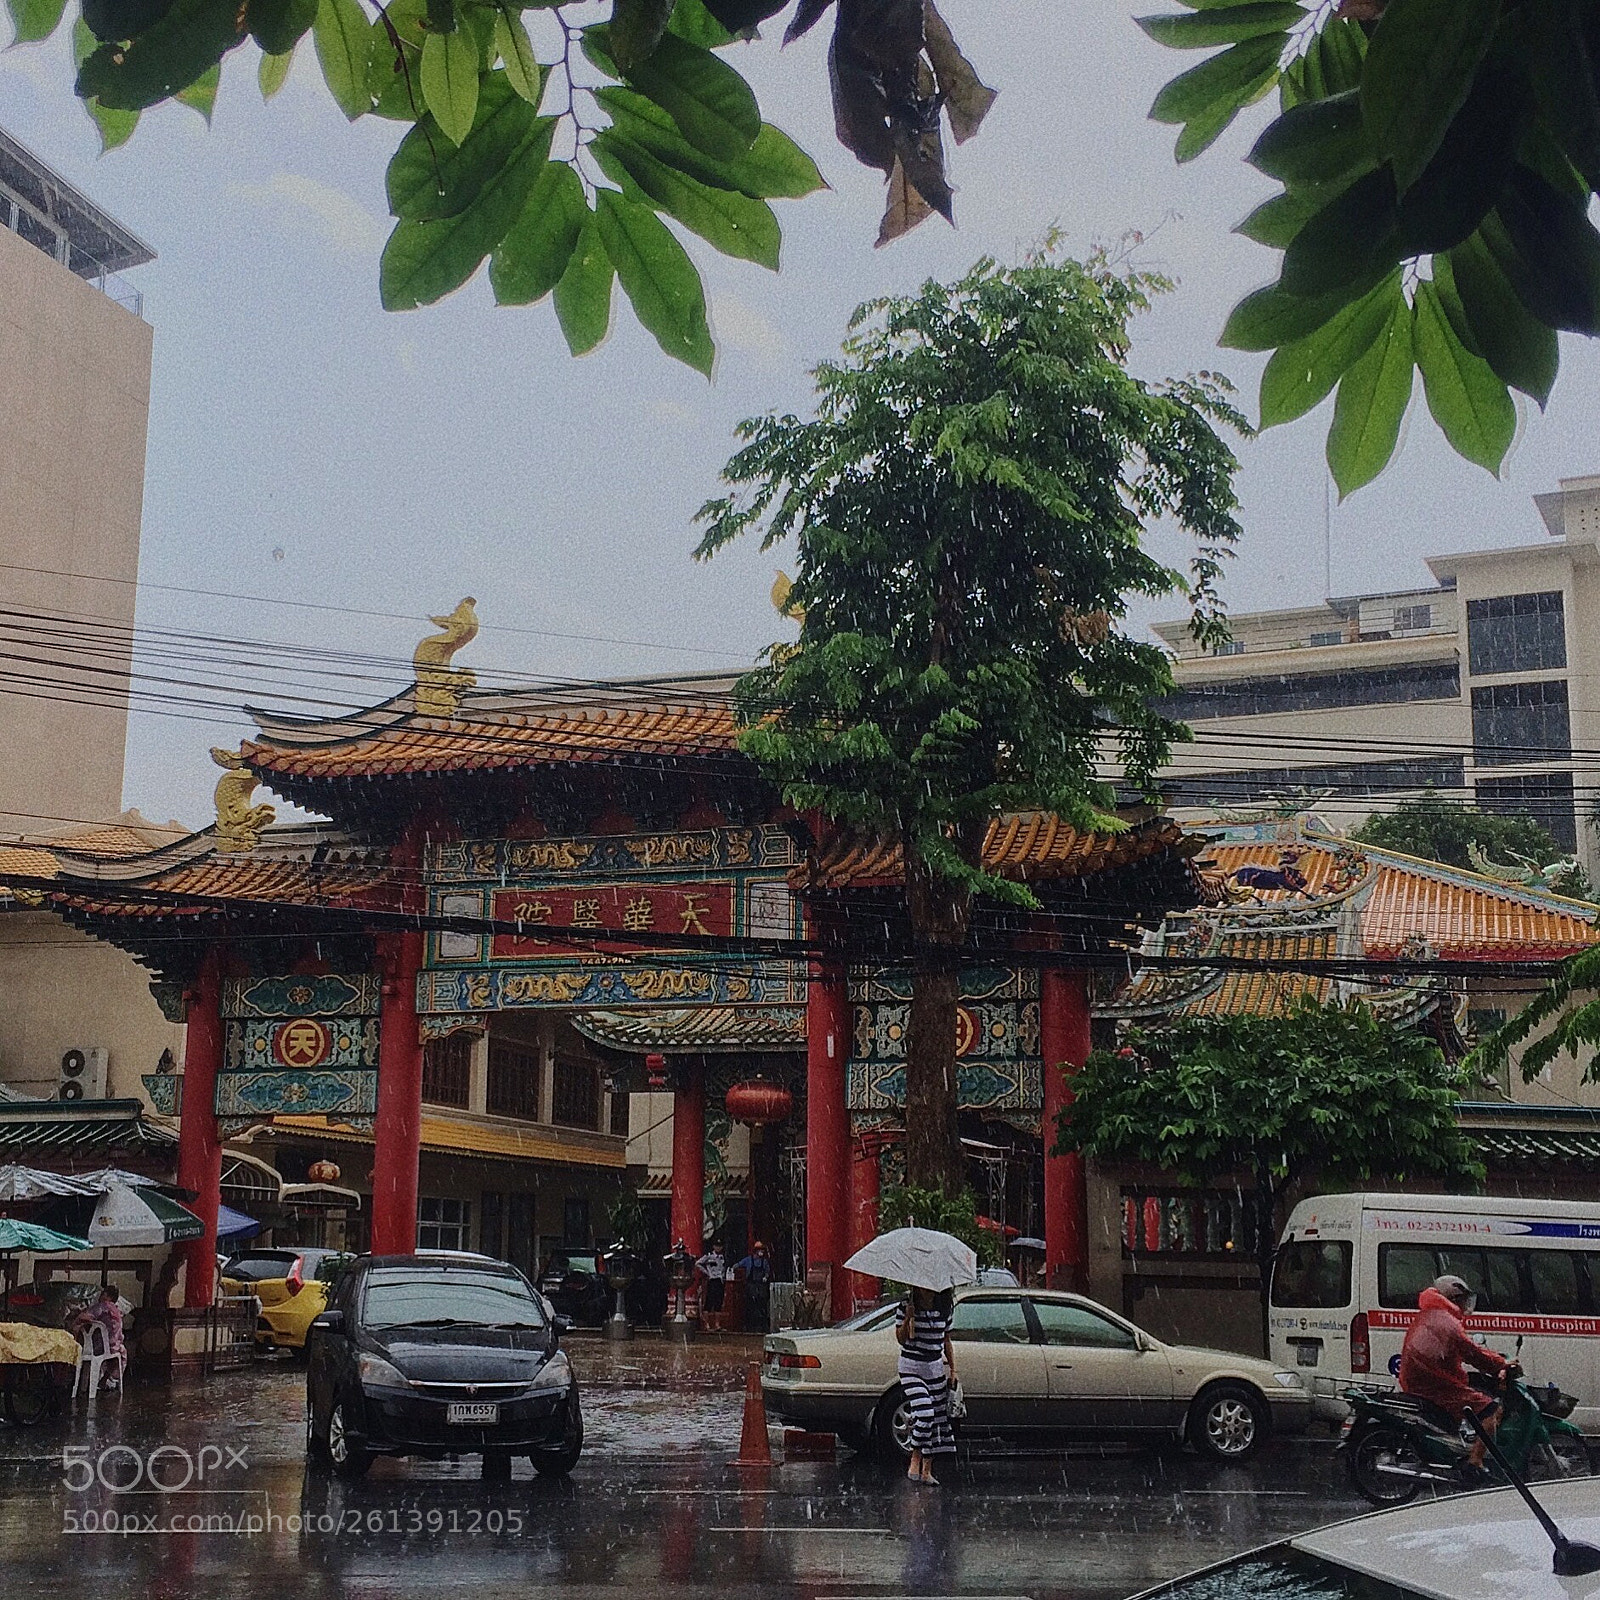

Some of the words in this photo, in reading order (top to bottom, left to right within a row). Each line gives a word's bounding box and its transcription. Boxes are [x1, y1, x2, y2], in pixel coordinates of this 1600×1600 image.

[289, 1028, 316, 1058] 天
[1461, 1314, 1536, 1330] oundation
[1539, 1319, 1597, 1333] Hospital
